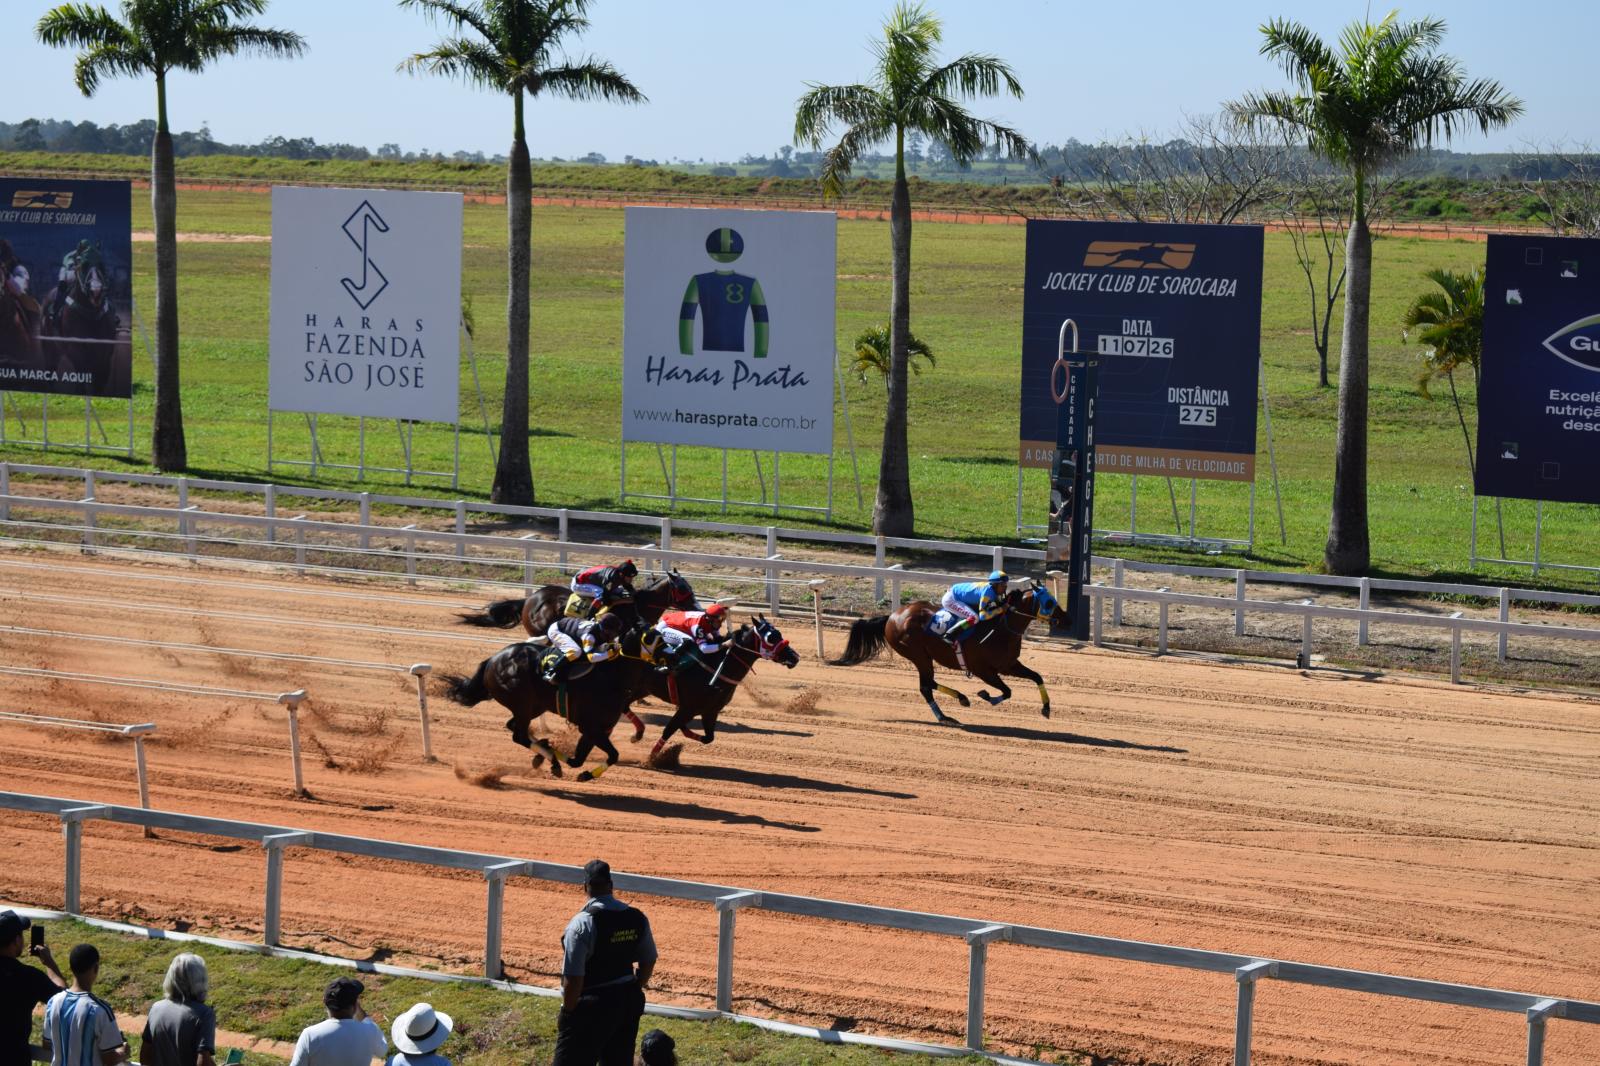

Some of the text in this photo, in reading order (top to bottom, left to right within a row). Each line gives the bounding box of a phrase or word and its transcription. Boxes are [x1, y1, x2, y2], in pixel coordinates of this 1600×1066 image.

[0, 210, 96, 225] CKEY CLUB DE SOROCABA
[1042, 272, 1237, 296] JOCKEY CLUB DE SOROCABA
[306, 314, 423, 332] HARAS
[1122, 319, 1153, 336] DATA
[305, 332, 425, 359] FAZENDA
[20, 369, 59, 381] MARCA
[61, 371, 92, 384] AQUI!
[304, 358, 425, 391] SÃO JOSÉ
[646, 355, 810, 391] Haras Prata
[1168, 385, 1229, 406] DISTÂNCIA
[633, 408, 817, 430] www.harasprata.com.br
[1068, 375, 1076, 445] CHEGADA
[1181, 408, 1215, 423] 275
[1025, 448, 1033, 460] A
[1035, 449, 1054, 462] CAS
[1120, 454, 1133, 467] DE
[1135, 455, 1167, 470] MILHA
[1169, 457, 1182, 470] DE
[1184, 458, 1247, 475] VELOCIDADE
[1082, 398, 1094, 581] CHEGADA
